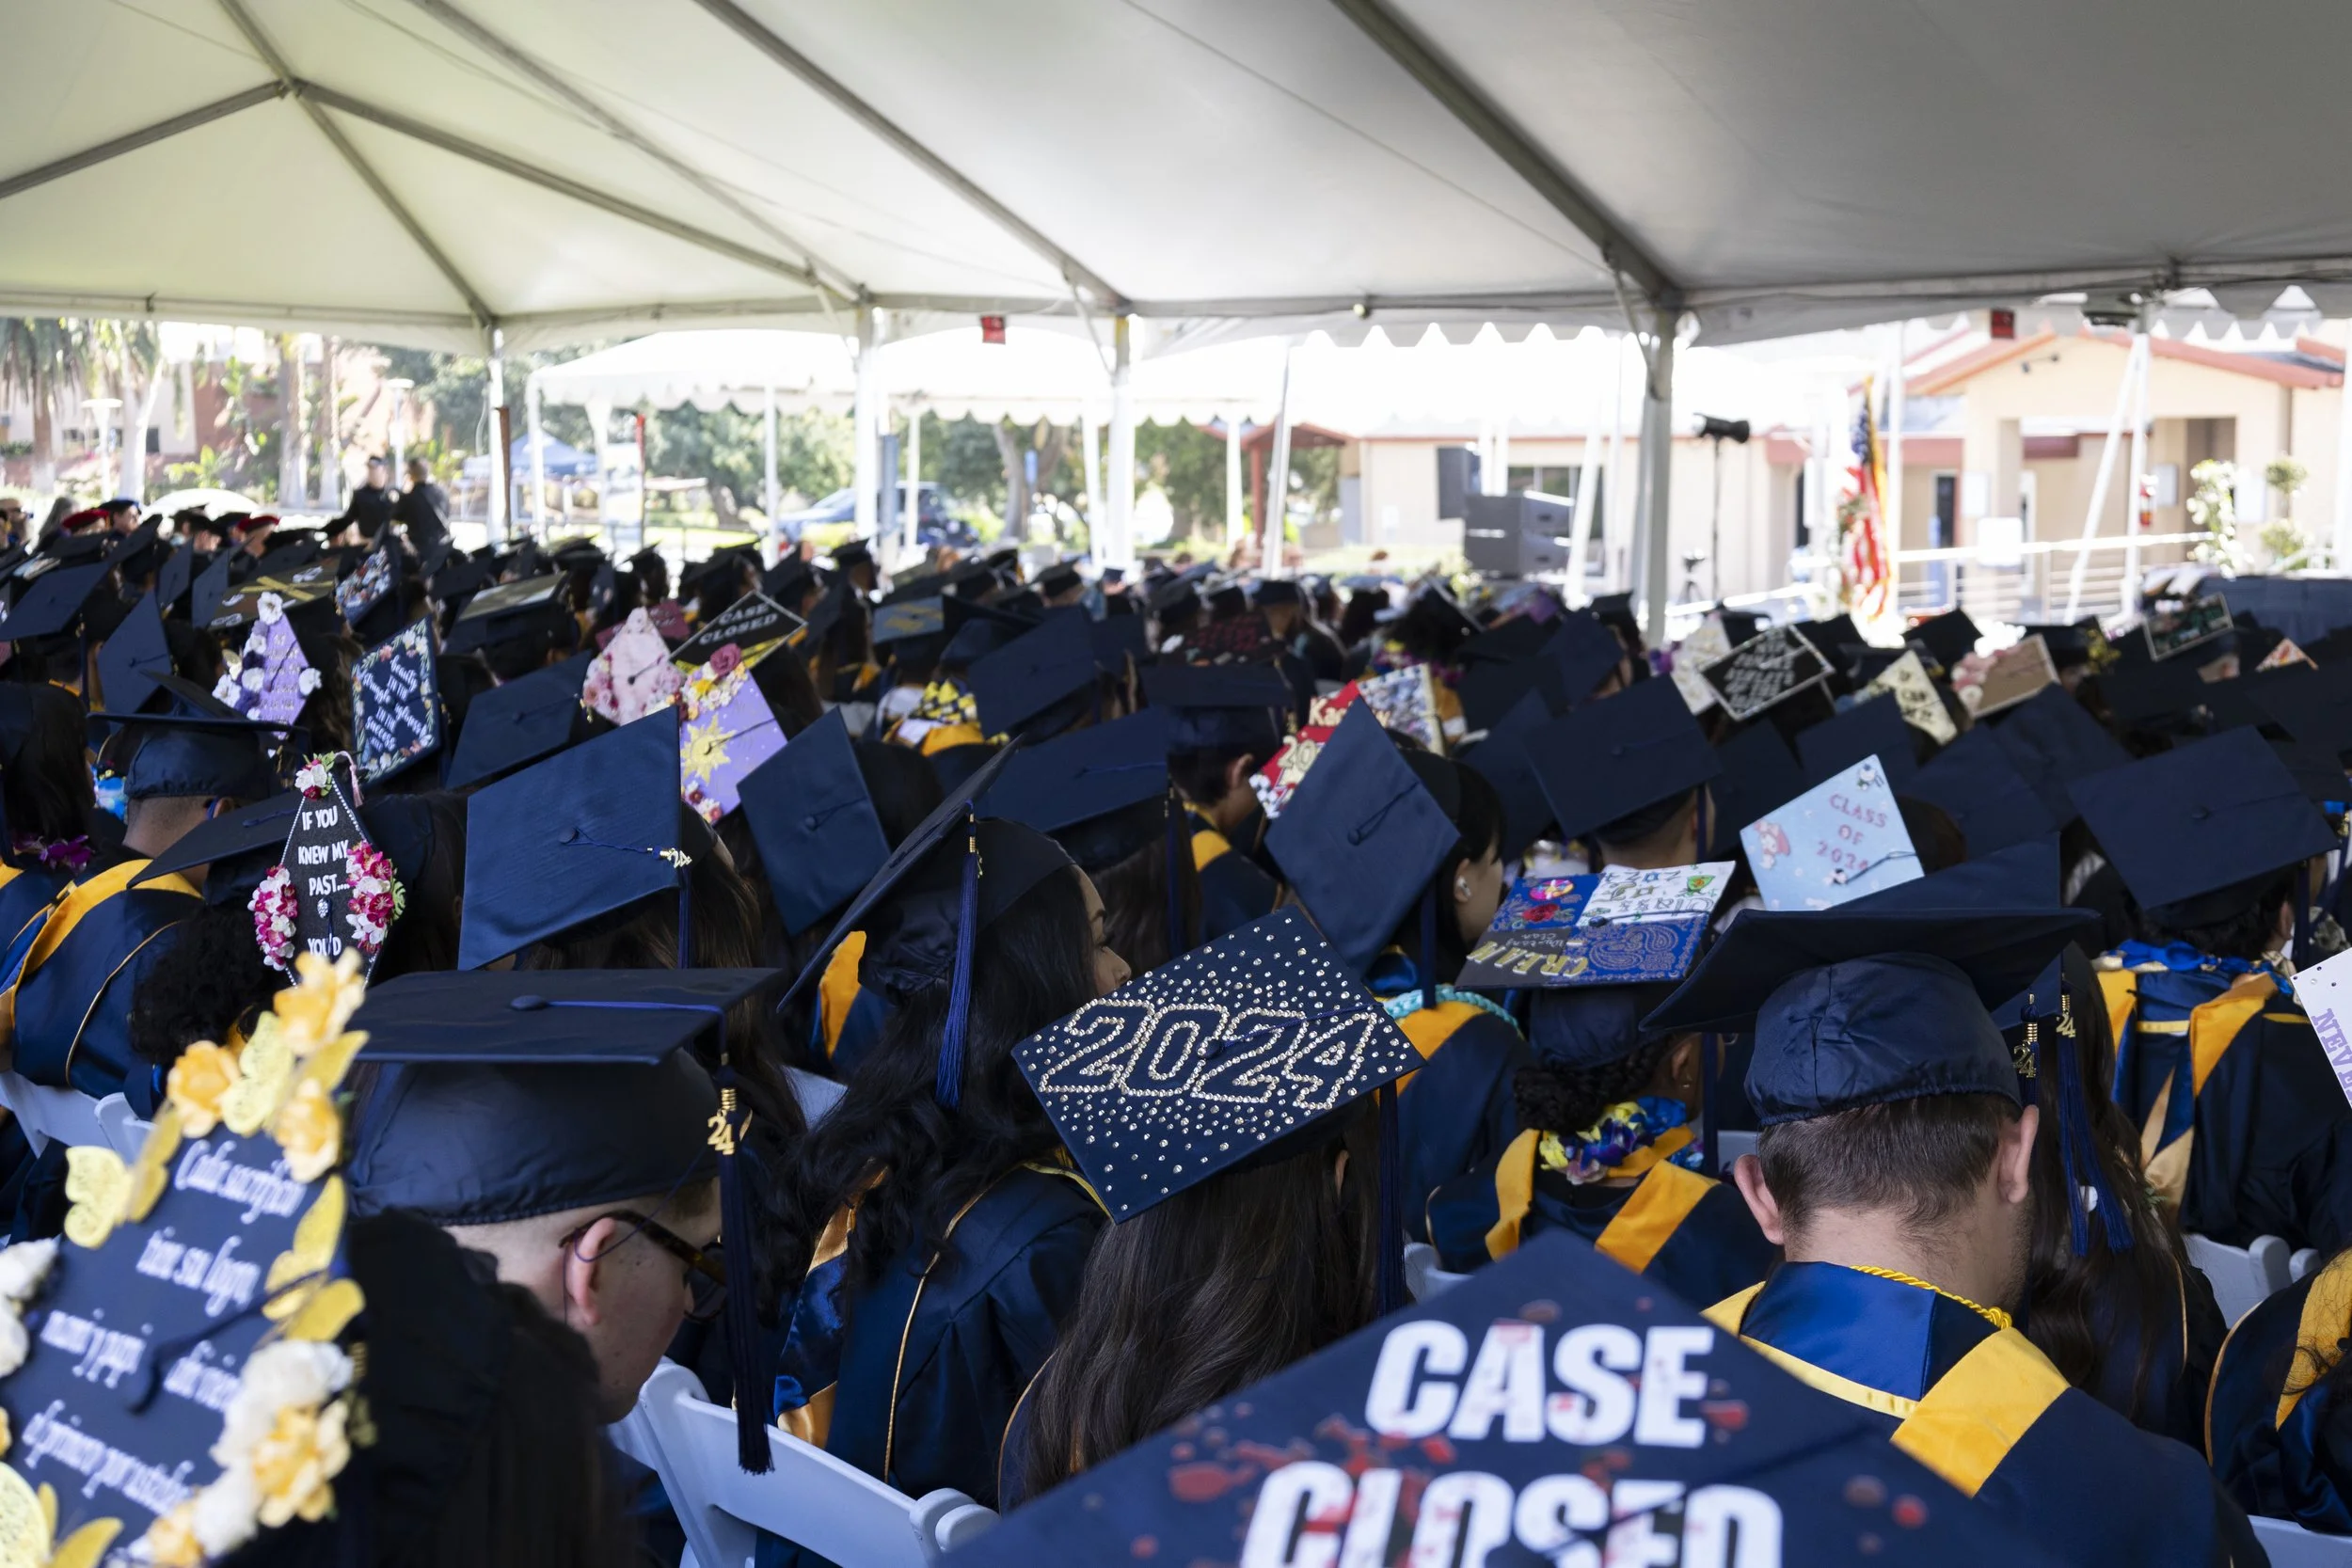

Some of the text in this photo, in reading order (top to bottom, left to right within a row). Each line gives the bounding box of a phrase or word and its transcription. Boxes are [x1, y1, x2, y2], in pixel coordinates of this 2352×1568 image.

[699, 613, 778, 645] CLOSED
[718, 602, 770, 626] CASE
[1277, 735, 1323, 772] 20
[302, 806, 339, 831] IF YOU
[1829, 793, 1889, 829] CLASS
[1837, 823, 1866, 846] OF
[297, 840, 350, 865] KNEW MY
[667, 848, 693, 868] 24
[2057, 1015, 2076, 1038] 24
[1038, 998, 1378, 1112] 2024
[2012, 1045, 2037, 1079] 24
[2312, 1008, 2352, 1101] NEVE
[707, 1116, 736, 1155] 24
[1364, 1318, 1715, 1449] CASE
[1239, 1461, 1783, 1568] CLOSED
